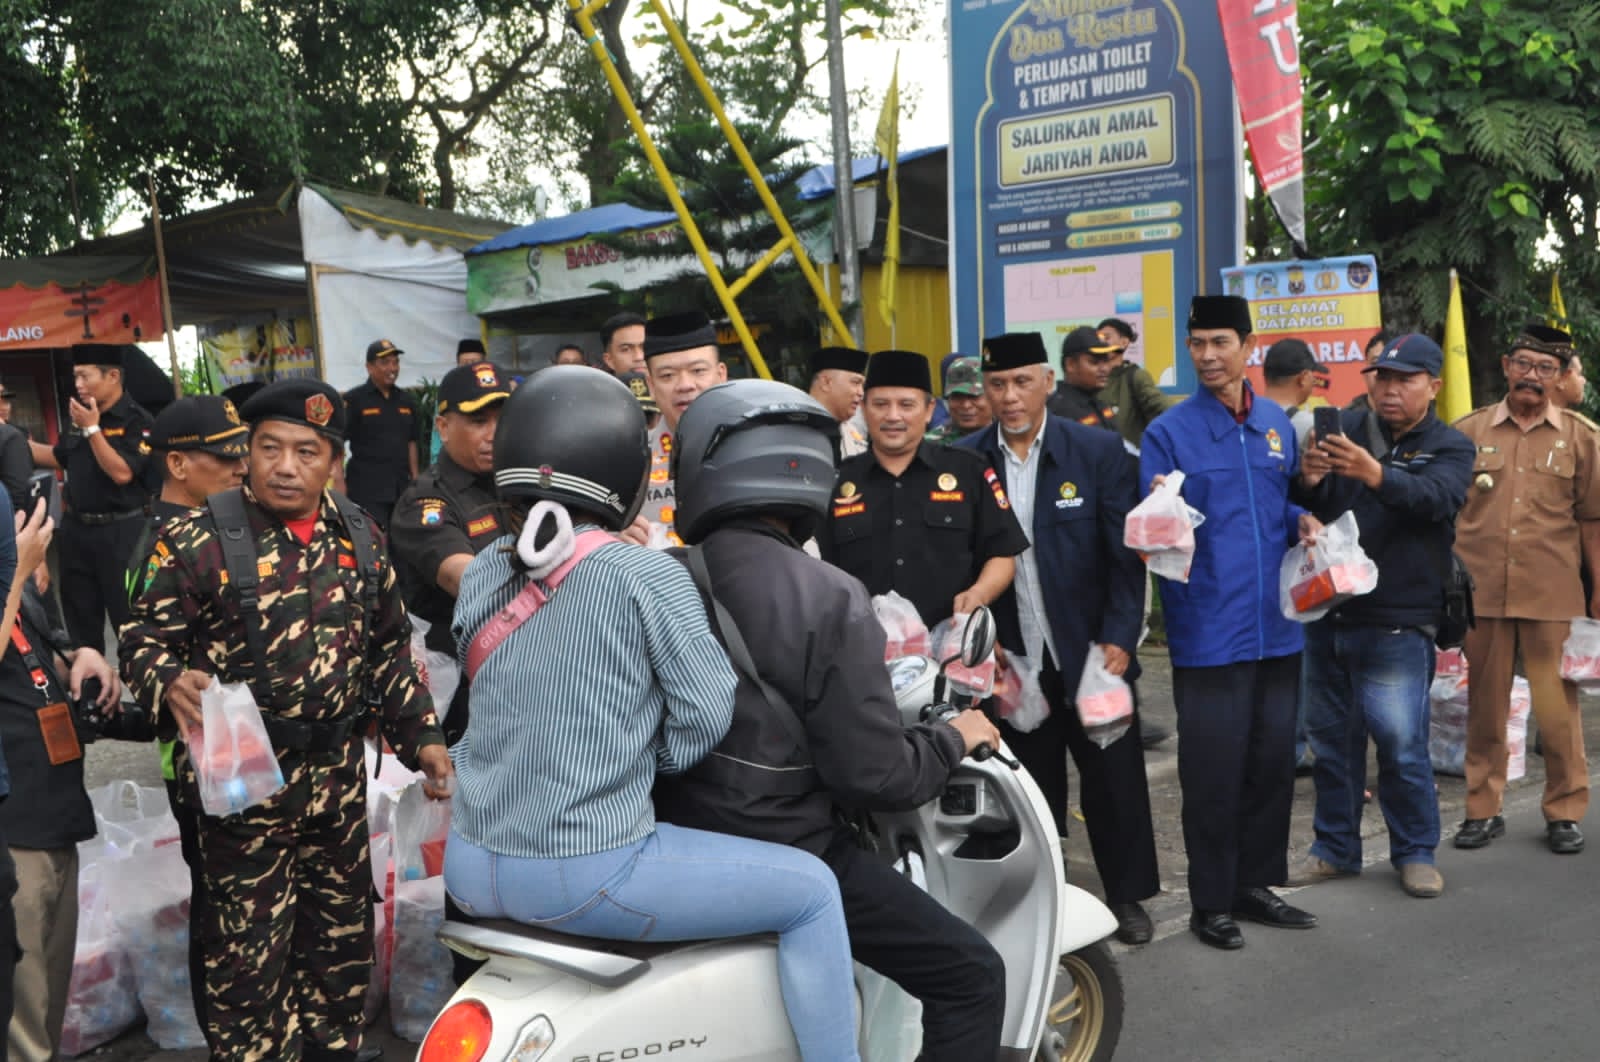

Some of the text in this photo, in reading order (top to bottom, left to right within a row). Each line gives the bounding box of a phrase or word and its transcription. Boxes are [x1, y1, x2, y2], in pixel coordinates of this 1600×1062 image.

[1014, 42, 1152, 86] PERLUASAN TOILET
[1019, 69, 1147, 110] & TEMPAT WUDHU
[1012, 105, 1158, 148] SALURKAN AMAL
[1022, 139, 1147, 176] JARIYAH ANDA
[1257, 313, 1344, 329] DATANG DI
[1258, 300, 1338, 316] SELAMAT
